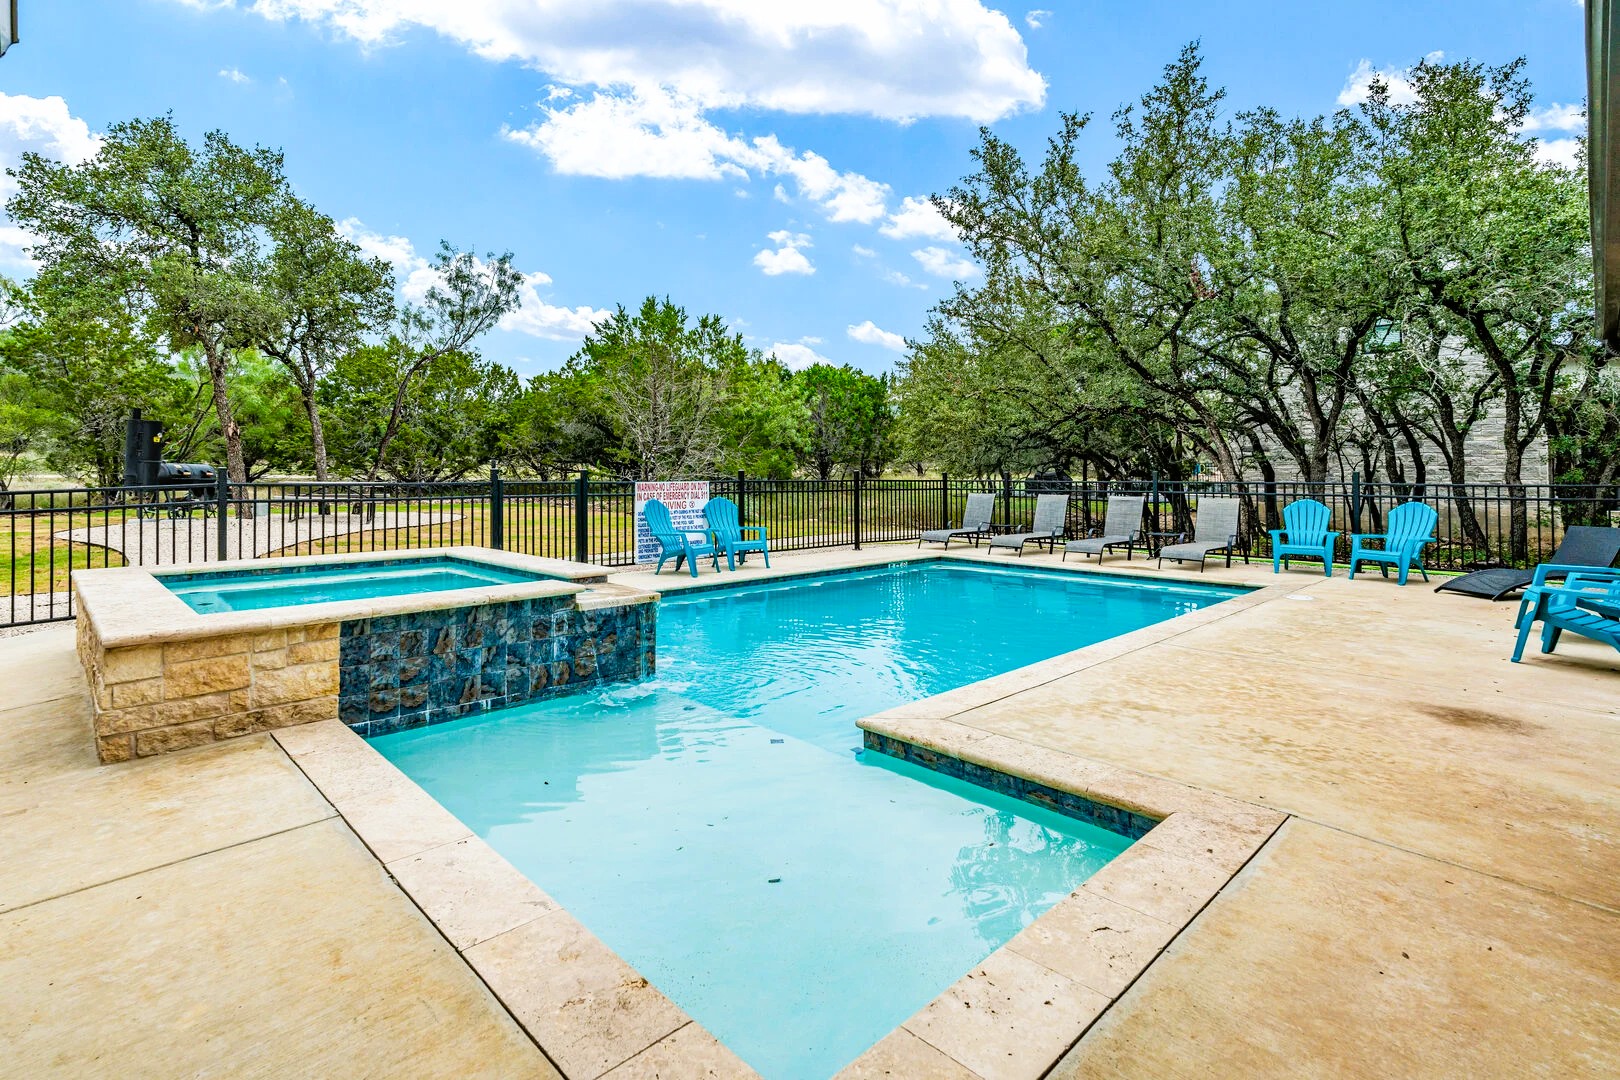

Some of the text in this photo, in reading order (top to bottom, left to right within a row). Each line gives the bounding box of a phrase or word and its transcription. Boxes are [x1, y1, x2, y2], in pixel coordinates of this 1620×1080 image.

[666, 482, 689, 491] LIFEGUARD
[691, 482, 697, 490] ON
[698, 482, 707, 490] DUTY
[637, 493, 642, 501] IN
[663, 491, 690, 500] EMERGENCY
[691, 491, 700, 499] DIAL
[663, 501, 686, 509] DIVING
